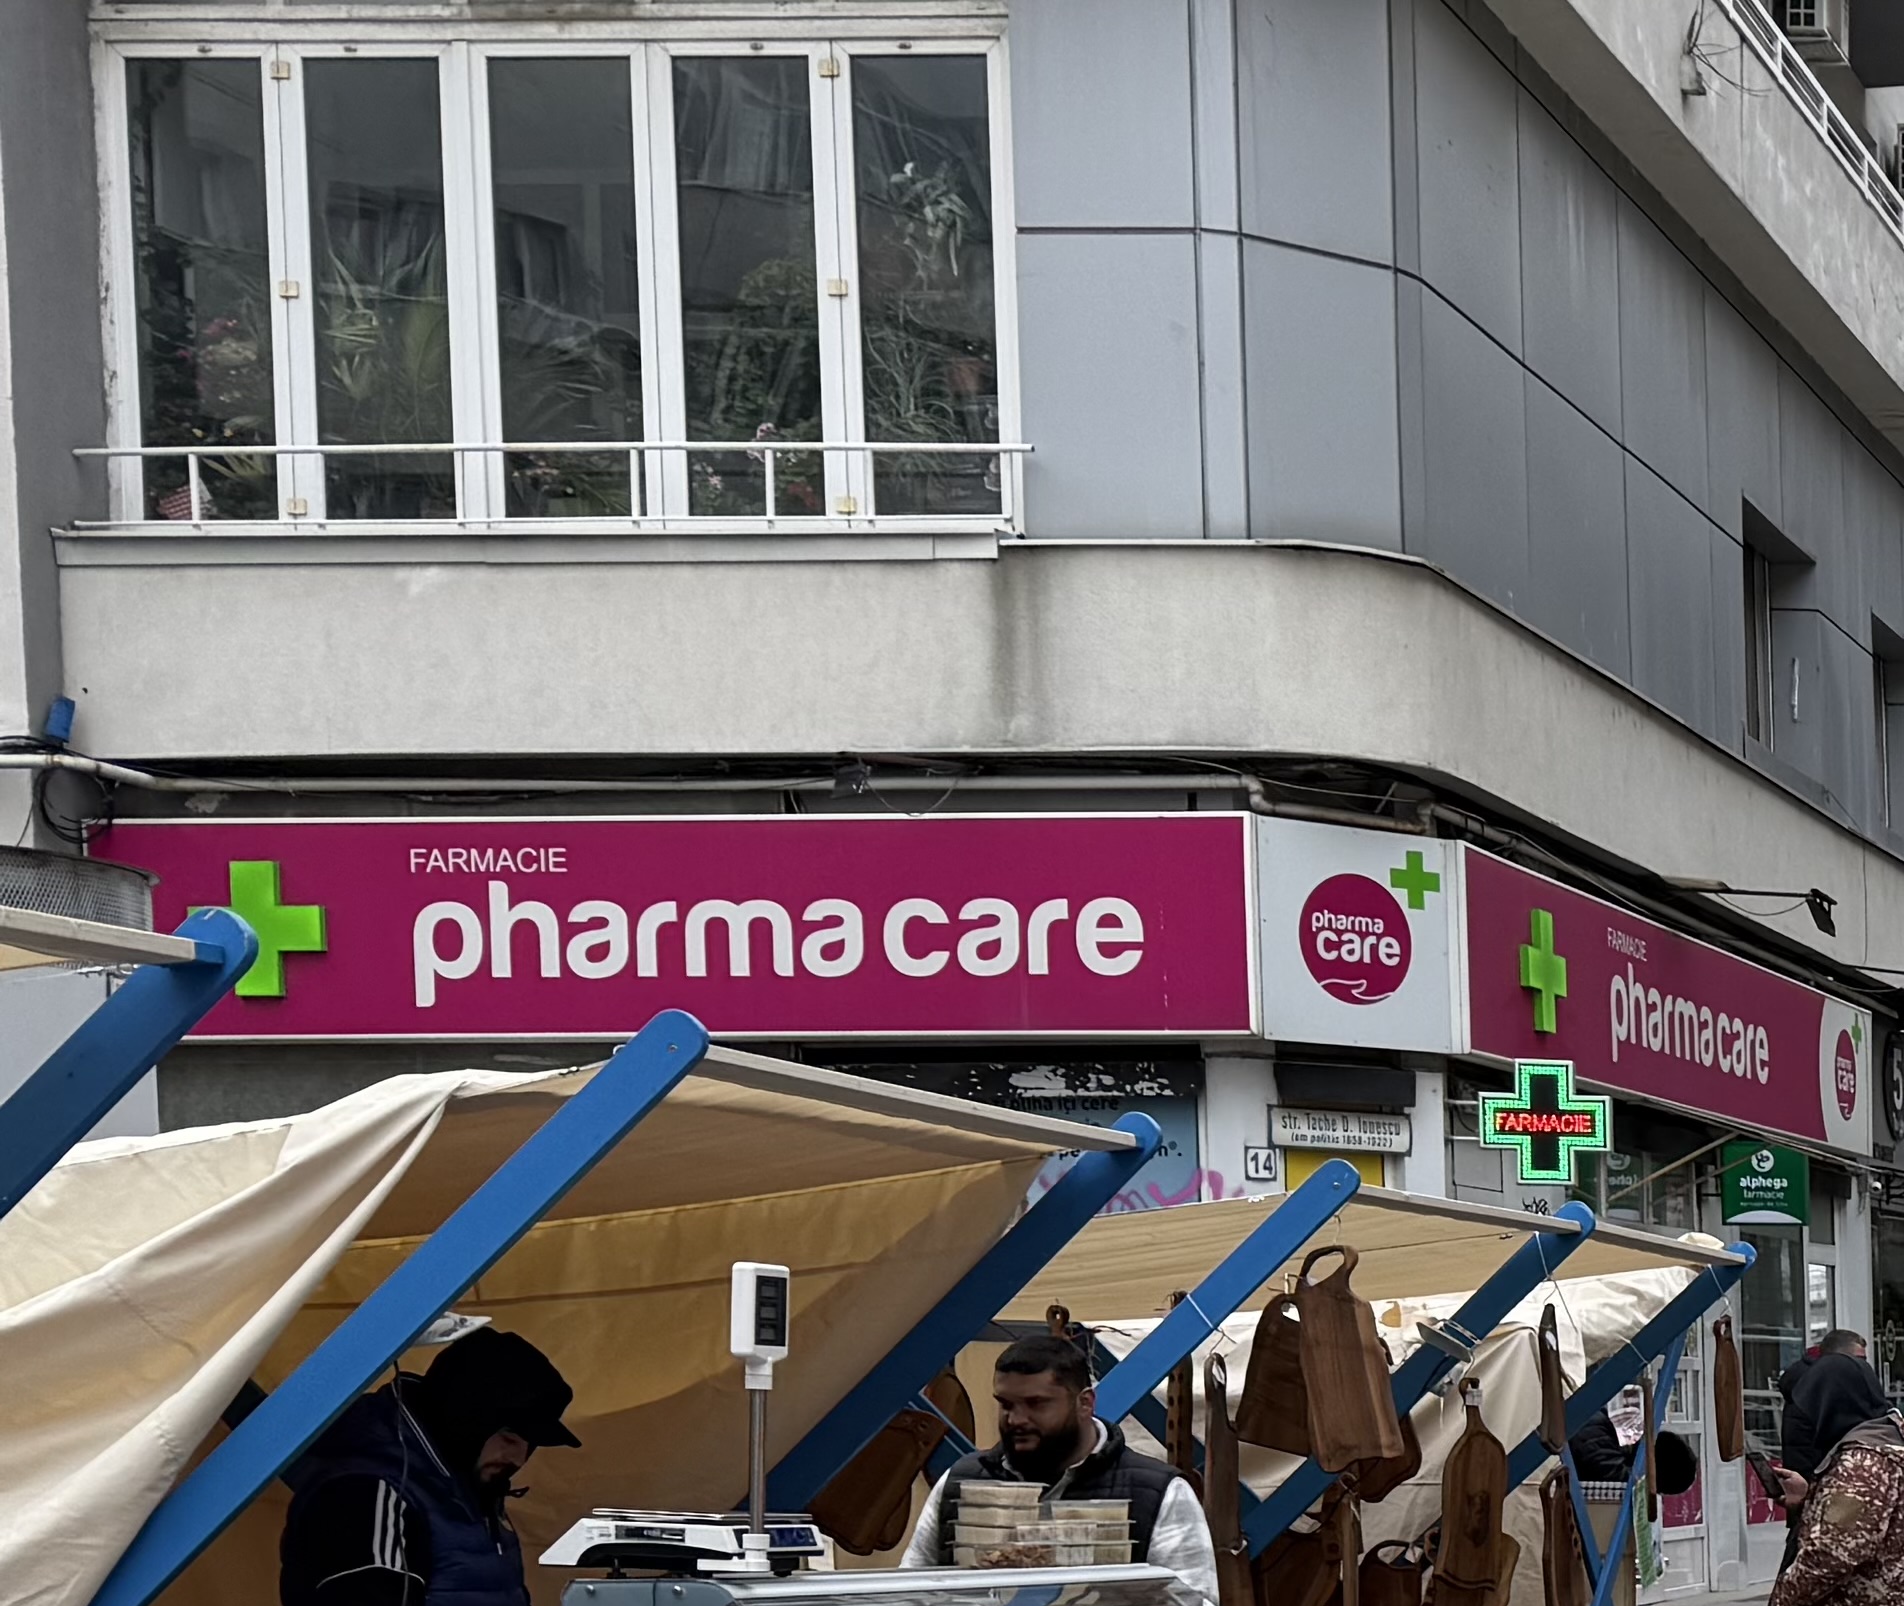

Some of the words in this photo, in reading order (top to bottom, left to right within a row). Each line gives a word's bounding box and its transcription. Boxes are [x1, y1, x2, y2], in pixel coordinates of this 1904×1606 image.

[409, 848, 568, 873] FARMACIE
[1311, 909, 1385, 934] pharma
[1316, 930, 1401, 966] care
[1607, 927, 1648, 962] FARMACIE
[1893, 1047, 1904, 1110] 5
[1281, 1114, 1301, 1130] str.
[1304, 1112, 1338, 1133] Tache
[1342, 1115, 1354, 1133] D.
[1358, 1118, 1401, 1136] Ionescu
[1494, 1112, 1592, 1133] FARMACIE
[1250, 1151, 1273, 1175] 14
[1739, 1176, 1788, 1189] alphega
